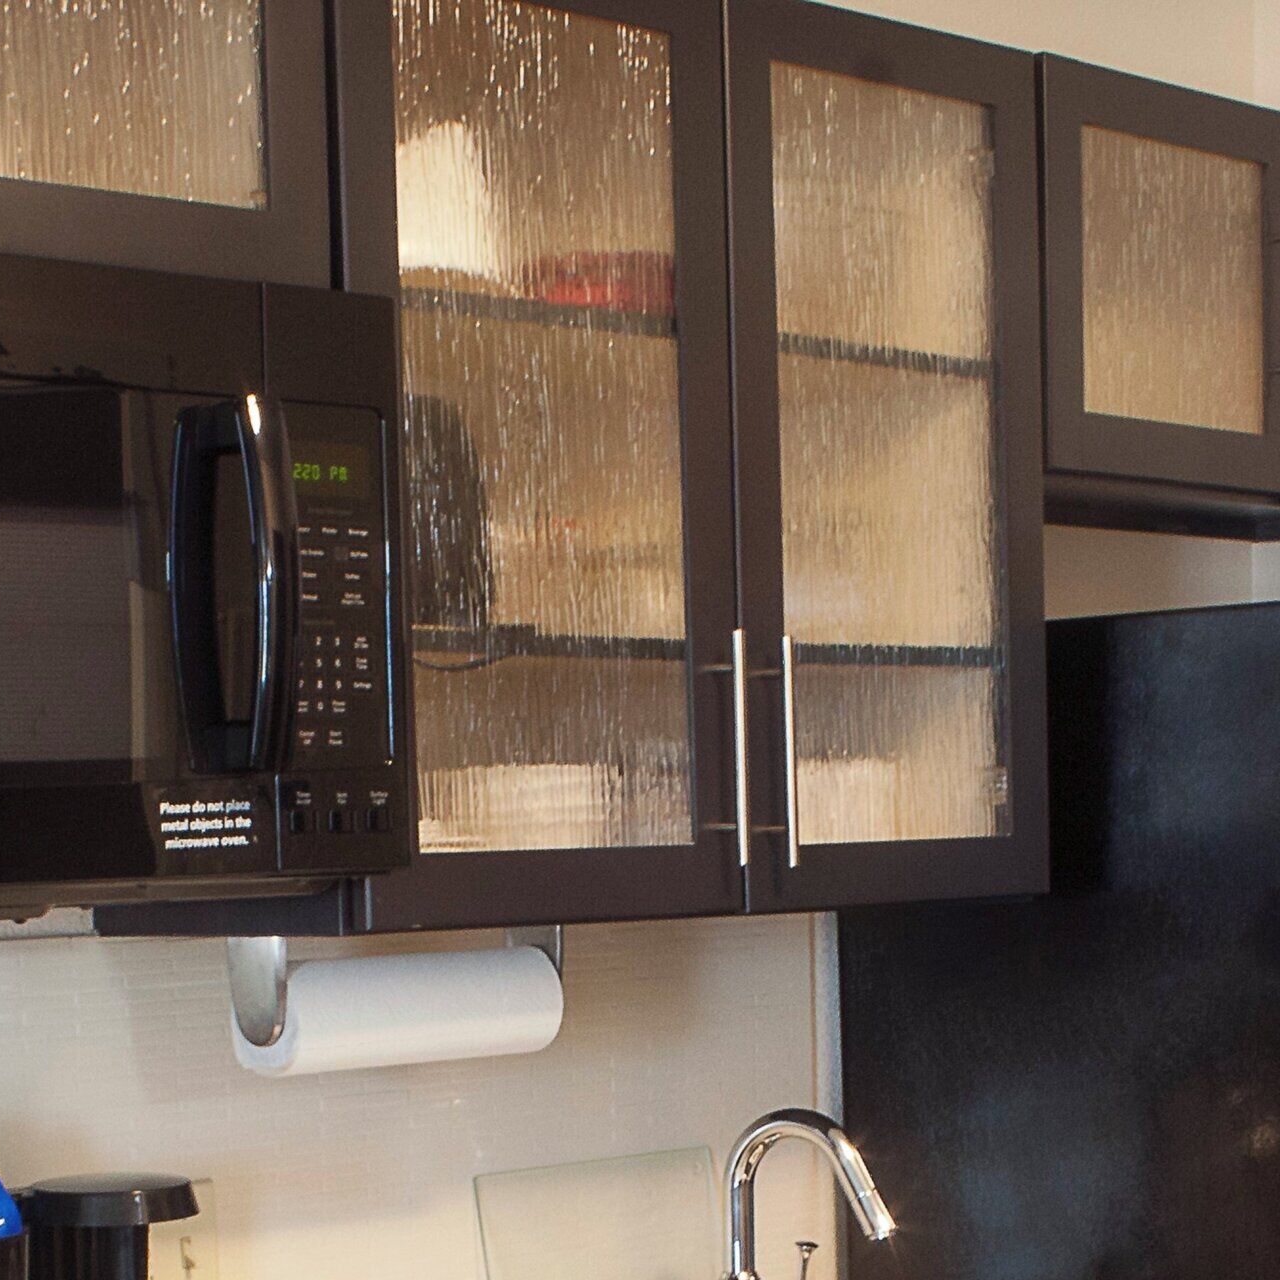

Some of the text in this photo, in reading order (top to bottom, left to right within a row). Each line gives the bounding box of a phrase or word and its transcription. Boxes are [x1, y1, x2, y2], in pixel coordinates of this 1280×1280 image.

[160, 799, 250, 815] Please do not place
[161, 816, 252, 833] metal objects in the
[165, 836, 220, 850] microwave
